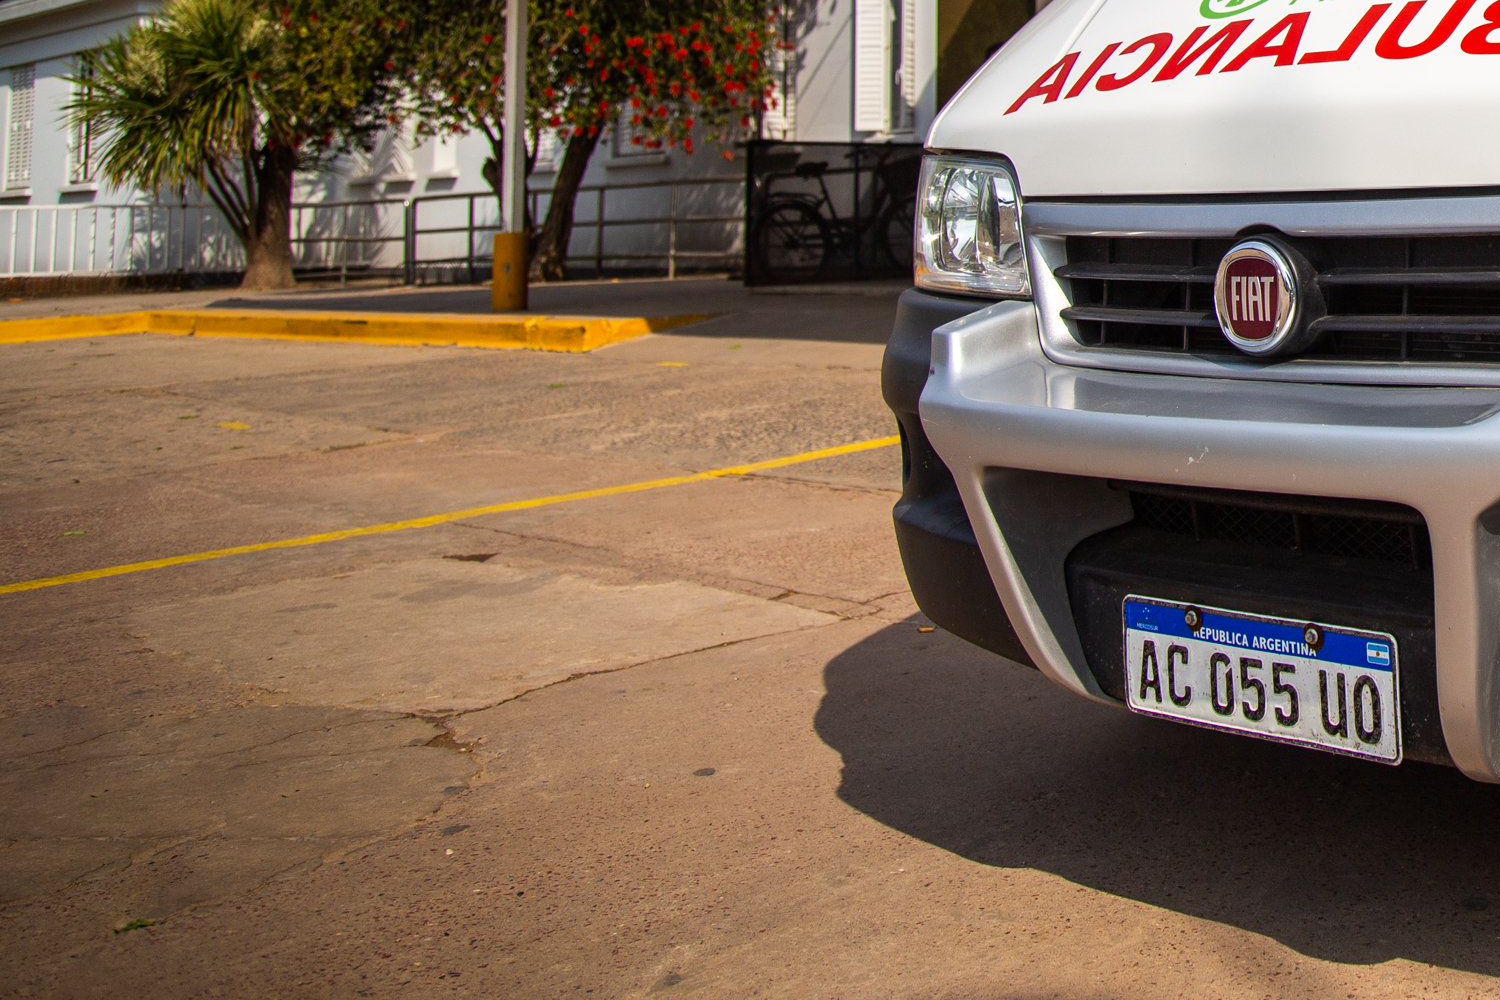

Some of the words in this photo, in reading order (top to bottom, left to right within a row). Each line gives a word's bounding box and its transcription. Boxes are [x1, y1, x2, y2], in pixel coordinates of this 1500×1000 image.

[1231, 275, 1275, 322] FIAT
[1136, 622, 1159, 631] MERCOSUR
[1252, 635, 1317, 658] ARGENTINA
[1139, 639, 1193, 709] AC
[1210, 651, 1301, 728] 055
[1318, 668, 1384, 746] UO
